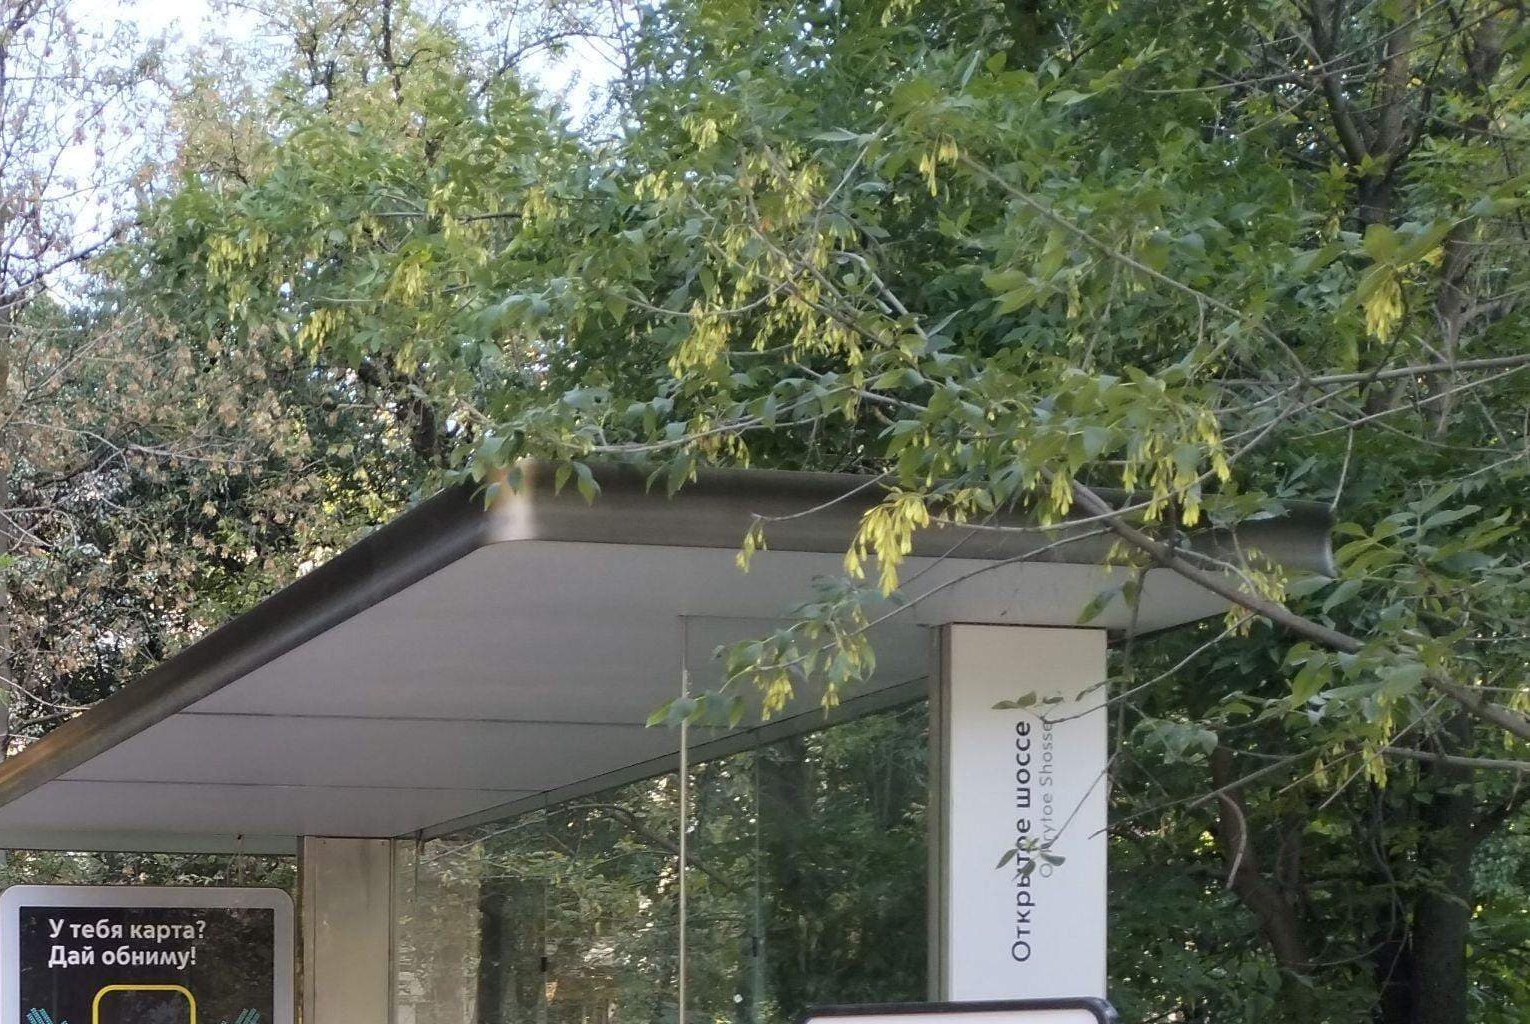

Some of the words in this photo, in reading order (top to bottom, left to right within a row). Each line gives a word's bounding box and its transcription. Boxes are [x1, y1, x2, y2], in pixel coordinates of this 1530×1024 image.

[1016, 720, 1031, 808] шоссе
[1039, 722, 1053, 787] Shosse
[1039, 792, 1056, 878] Orytoe
[48, 918, 65, 938] У
[69, 918, 122, 939] тебя
[130, 920, 207, 943] карта?
[48, 945, 95, 968] Дай
[101, 945, 196, 970] обниму!
